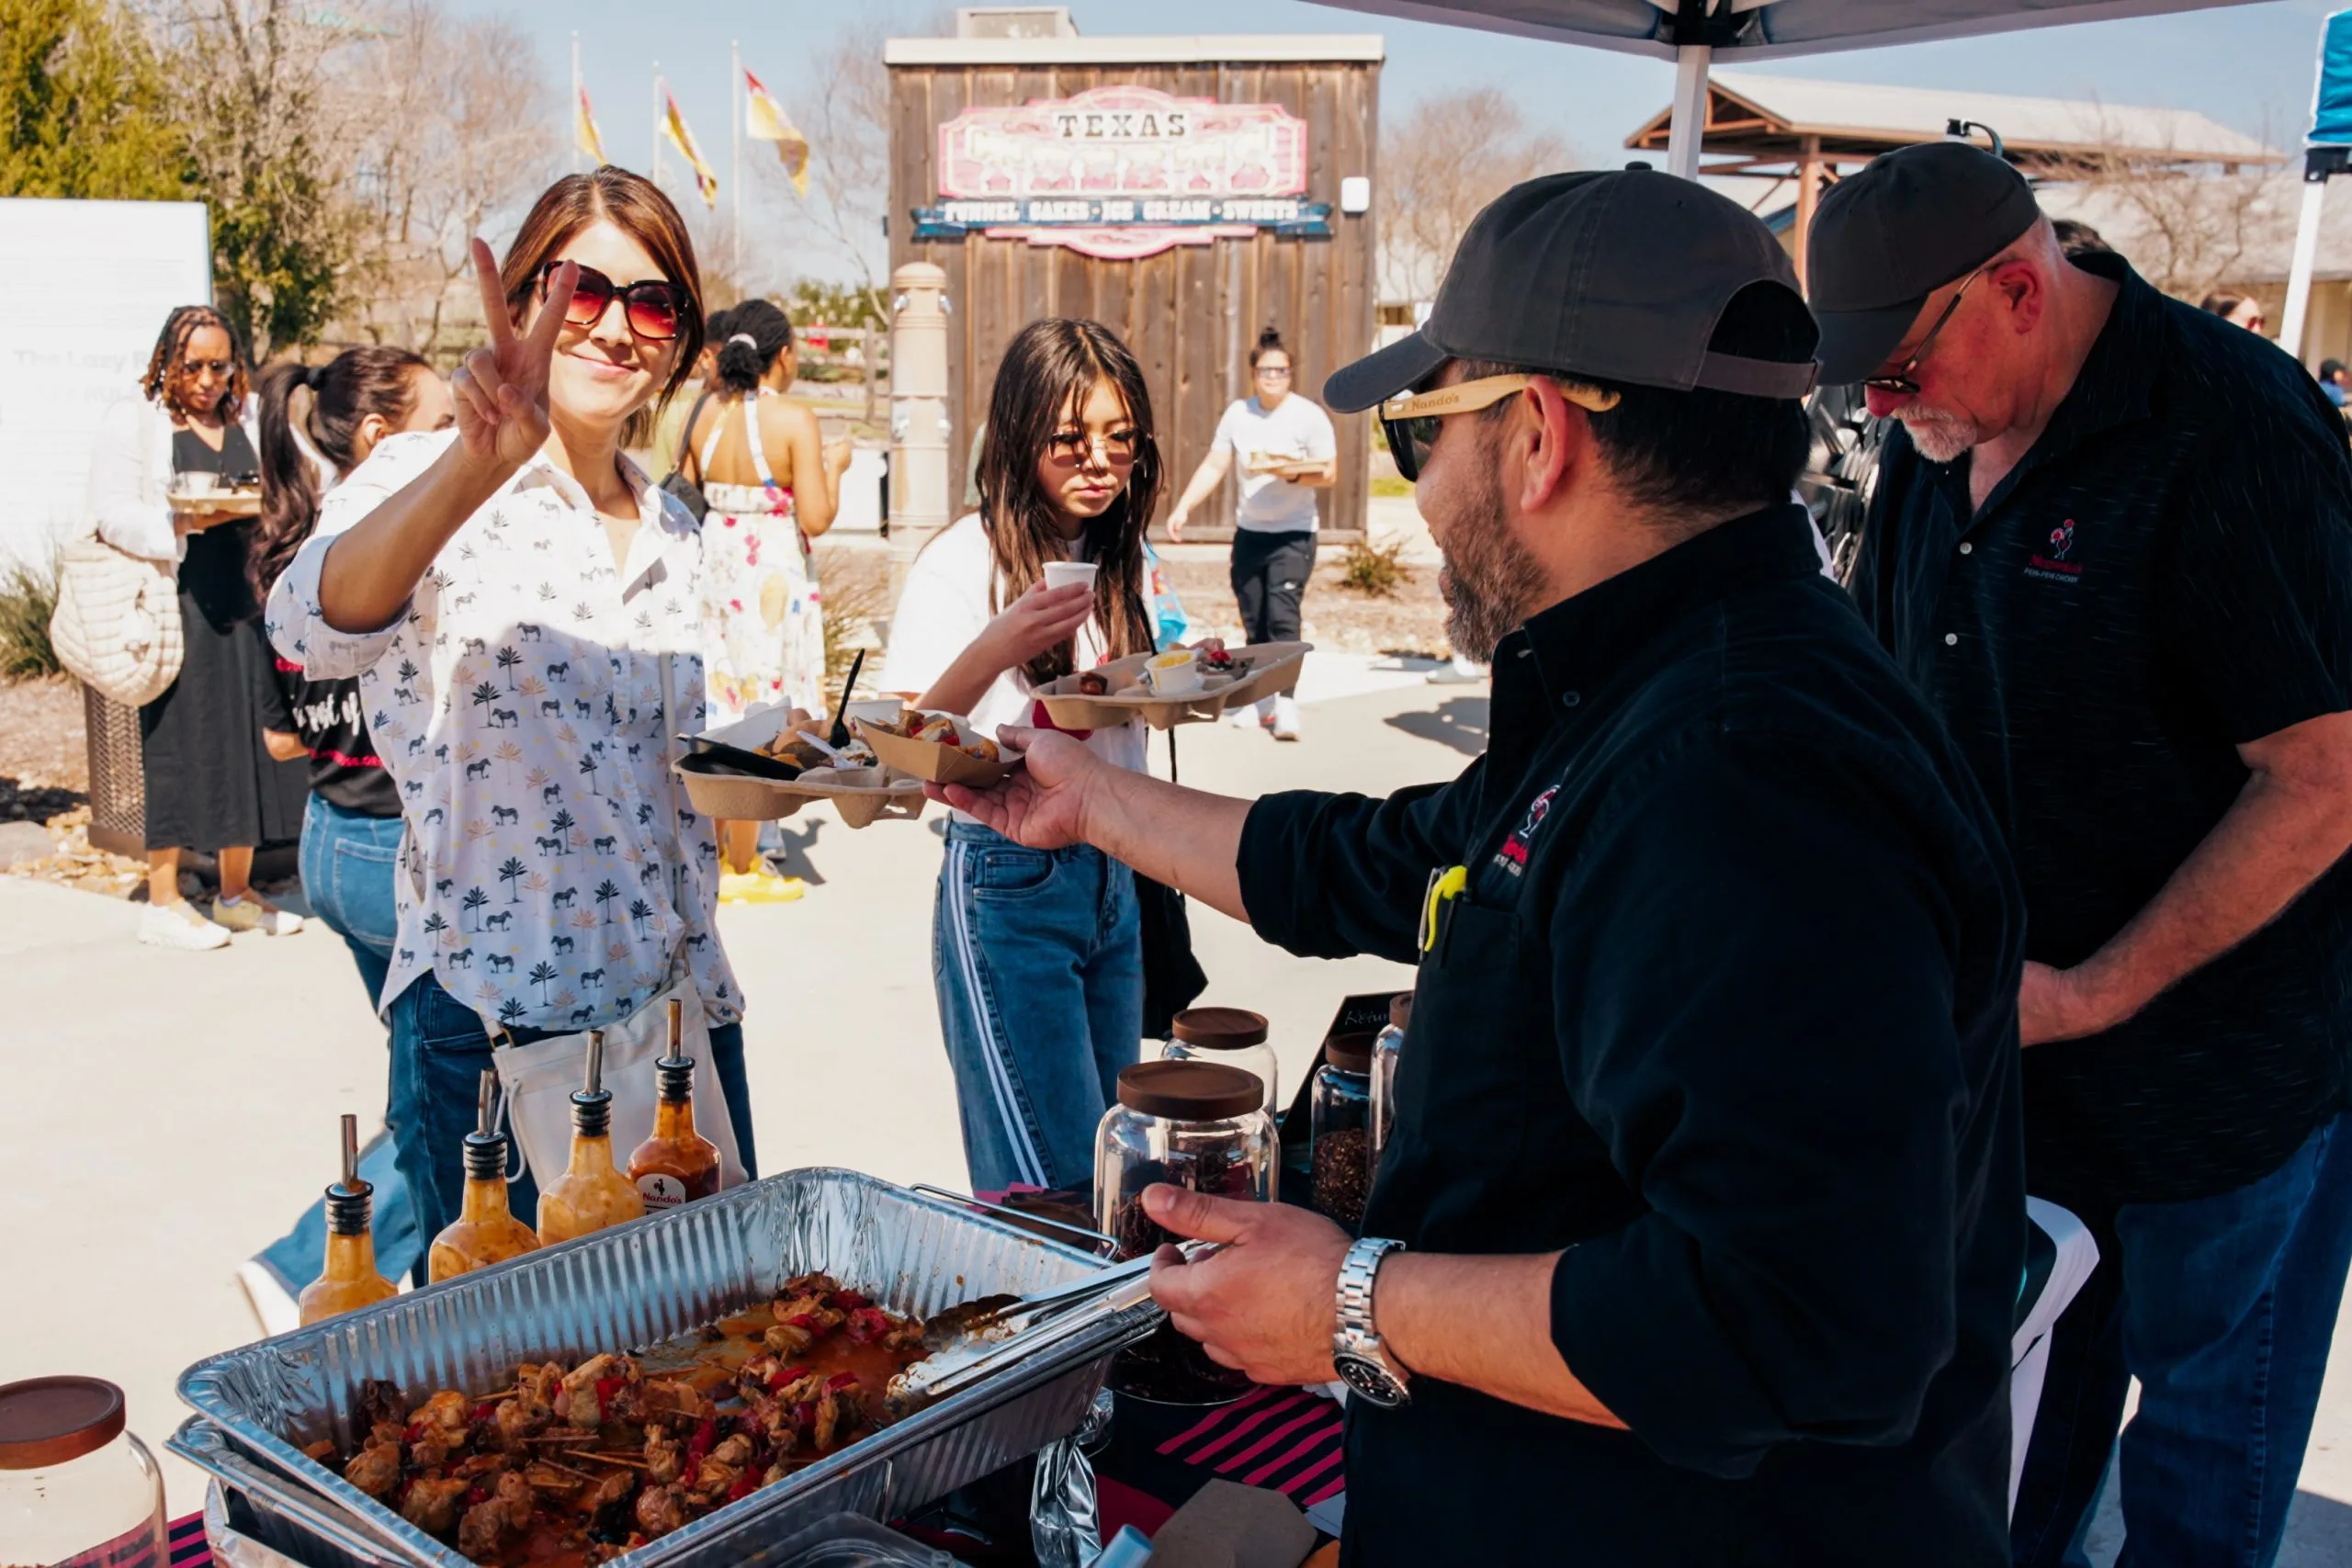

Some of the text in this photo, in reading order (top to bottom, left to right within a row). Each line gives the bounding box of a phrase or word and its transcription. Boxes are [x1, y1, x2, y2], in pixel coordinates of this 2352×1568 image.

[1057, 114, 1185, 138] TEXAS
[944, 199, 1298, 221] FUNNEL CAKES ICE CREAM SWEETS
[1411, 393, 1460, 412] Nando's
[643, 1192, 683, 1204] Nando's
